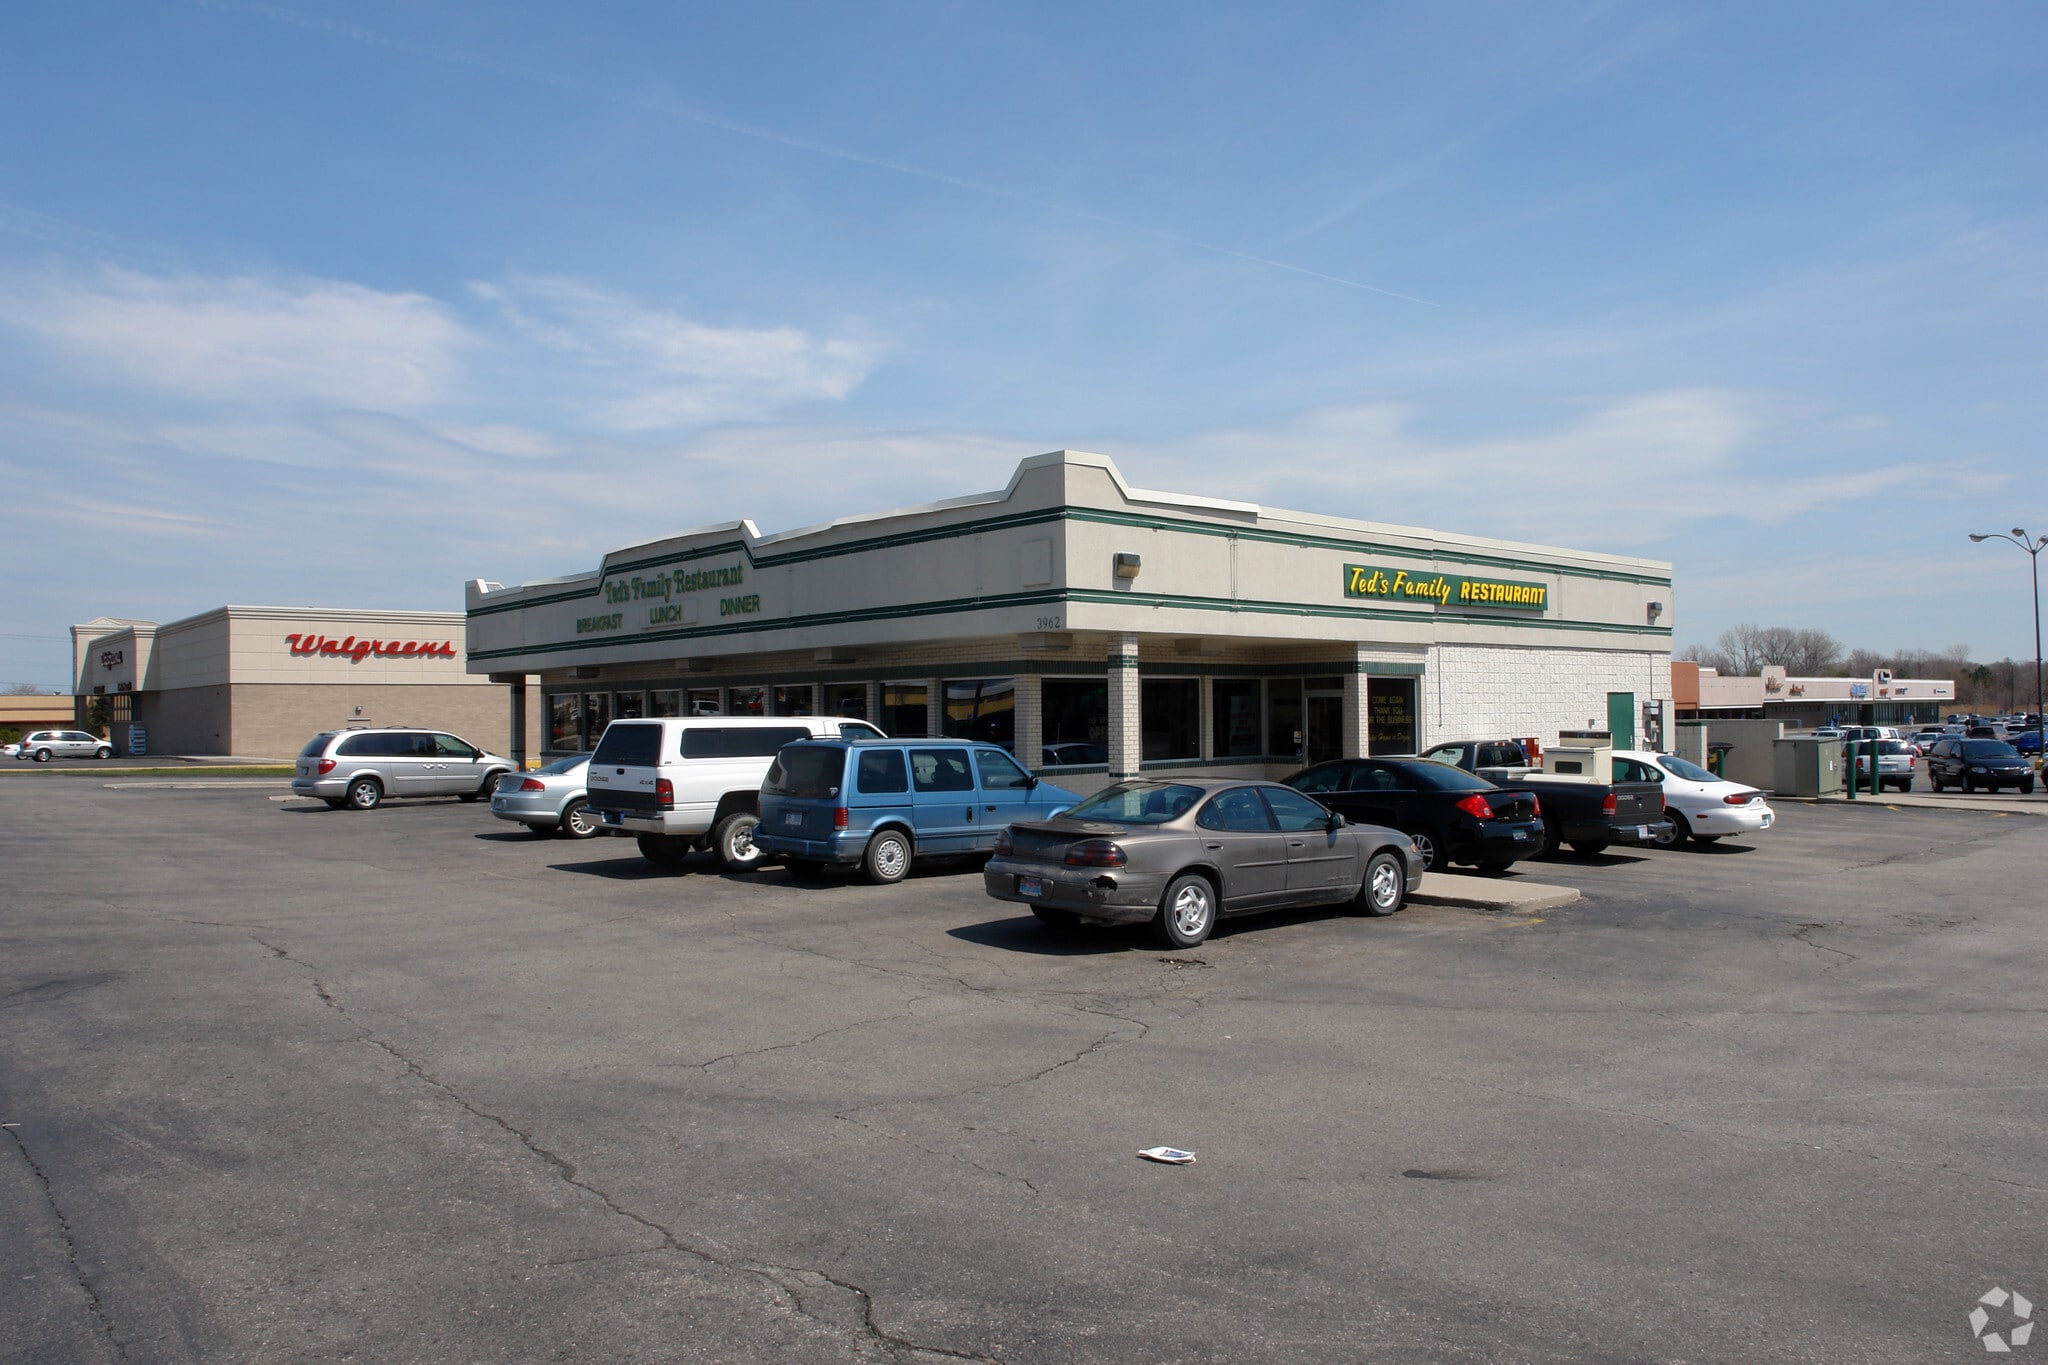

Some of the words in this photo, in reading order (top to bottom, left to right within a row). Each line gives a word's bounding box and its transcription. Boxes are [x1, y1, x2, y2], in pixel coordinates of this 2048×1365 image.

[605, 580, 630, 604] Ted's
[631, 572, 672, 602] Family
[673, 560, 744, 593] Restaurant
[1350, 568, 1389, 594] Ted's
[1392, 571, 1451, 605] Family
[1460, 581, 1545, 604] RESTAURANT
[576, 613, 623, 634] BREAKFAST
[649, 604, 682, 624] LUNCH
[720, 594, 760, 616] DINNER
[1036, 616, 1060, 630] 3962
[285, 633, 457, 661] Walgreens
